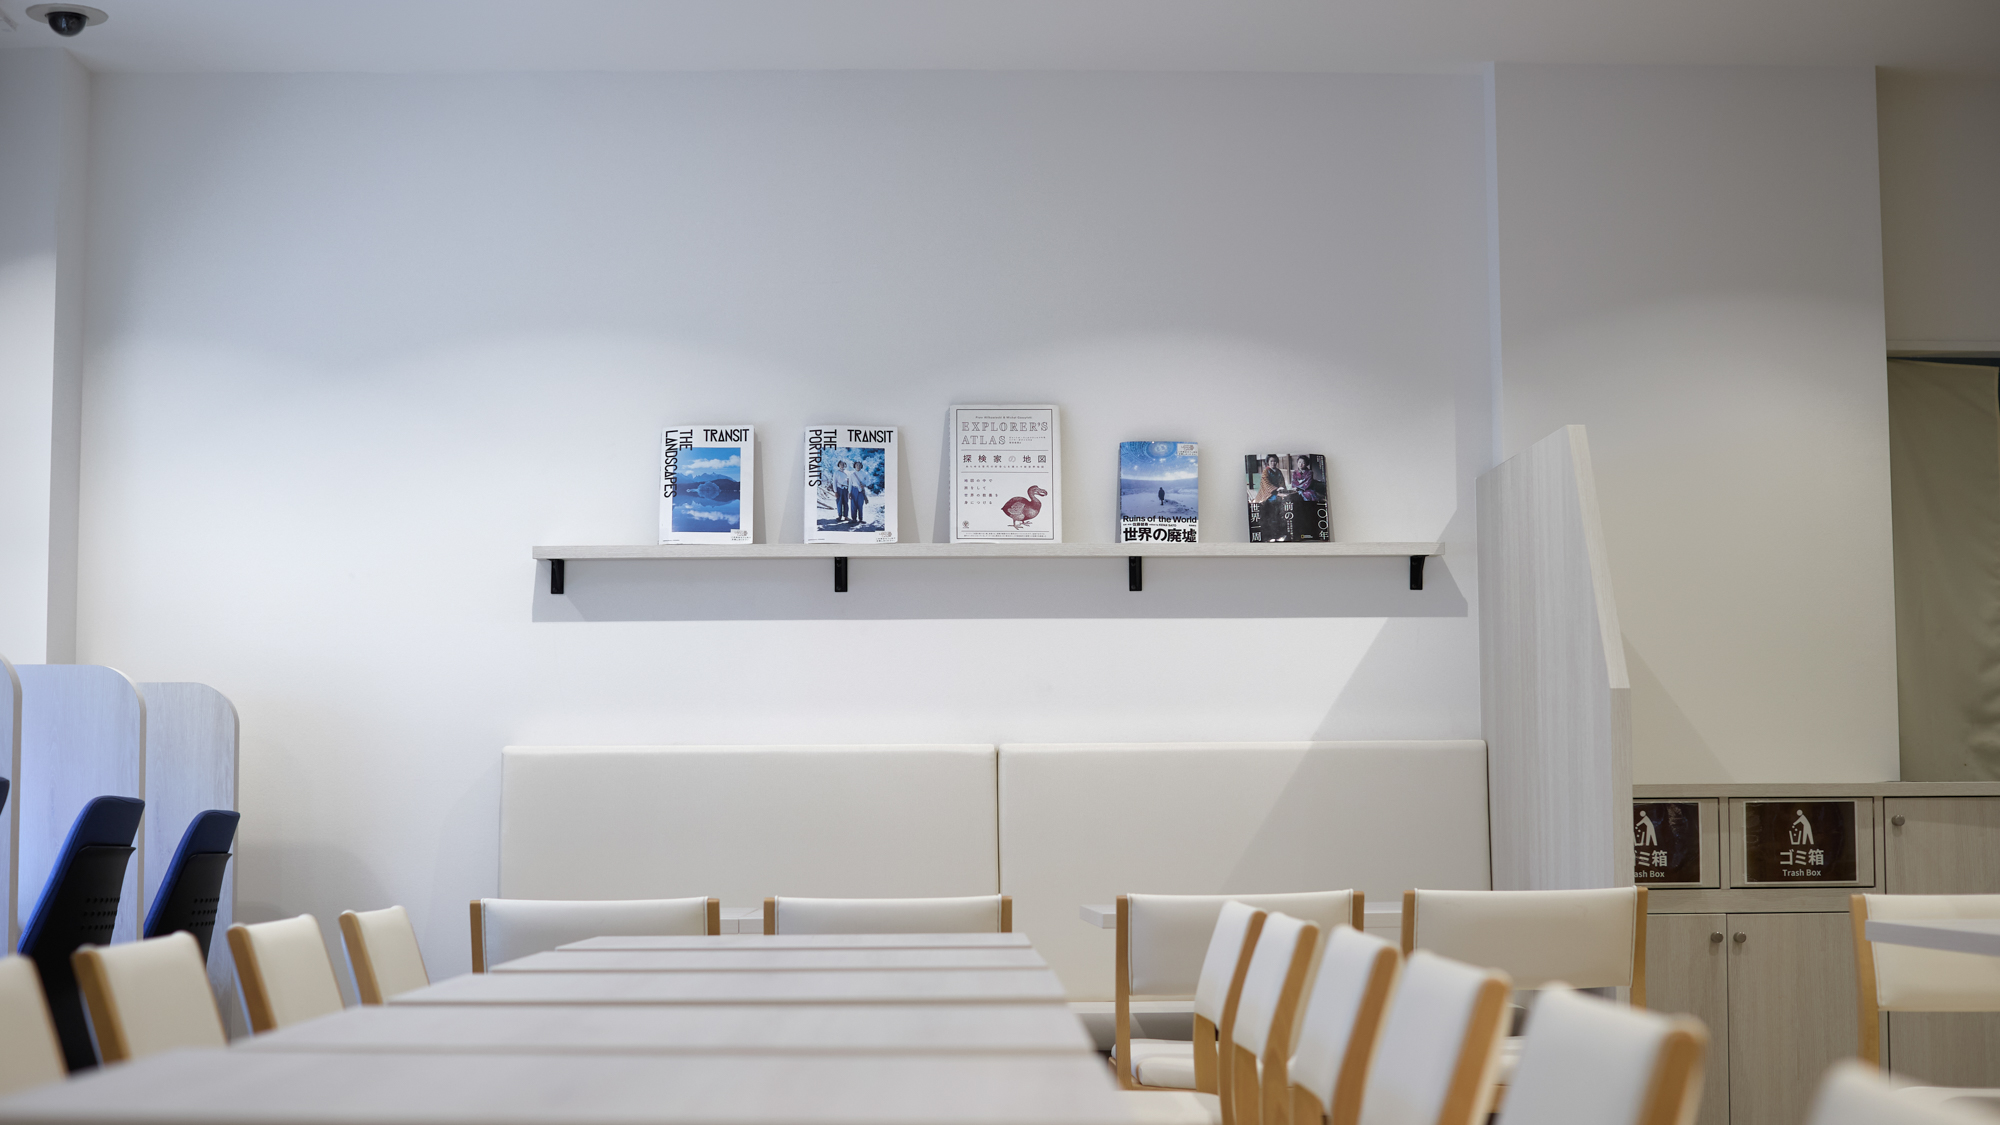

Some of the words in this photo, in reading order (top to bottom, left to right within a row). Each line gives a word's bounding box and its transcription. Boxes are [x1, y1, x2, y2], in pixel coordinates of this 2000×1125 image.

[961, 421, 1049, 432] EXPLORER'S
[679, 429, 693, 451] THE
[703, 429, 750, 442] TRANSIT
[823, 429, 837, 451] THE
[847, 429, 894, 443] TRANSIT
[961, 435, 1006, 445] ATLAS
[663, 430, 679, 498] LANDSCAPES
[808, 429, 822, 487] PORTRAITS
[1123, 515, 1146, 523] Ruins
[1147, 515, 1156, 523] of
[1158, 515, 1171, 523] the
[1172, 516, 1197, 524] World
[1123, 527, 1197, 543] 世界の廃墟
[1780, 849, 1824, 866] ゴミ箱
[1634, 870, 1648, 878] ash
[1650, 870, 1665, 878] Box
[1782, 869, 1804, 877] Trash
[1806, 869, 1821, 877] Box
